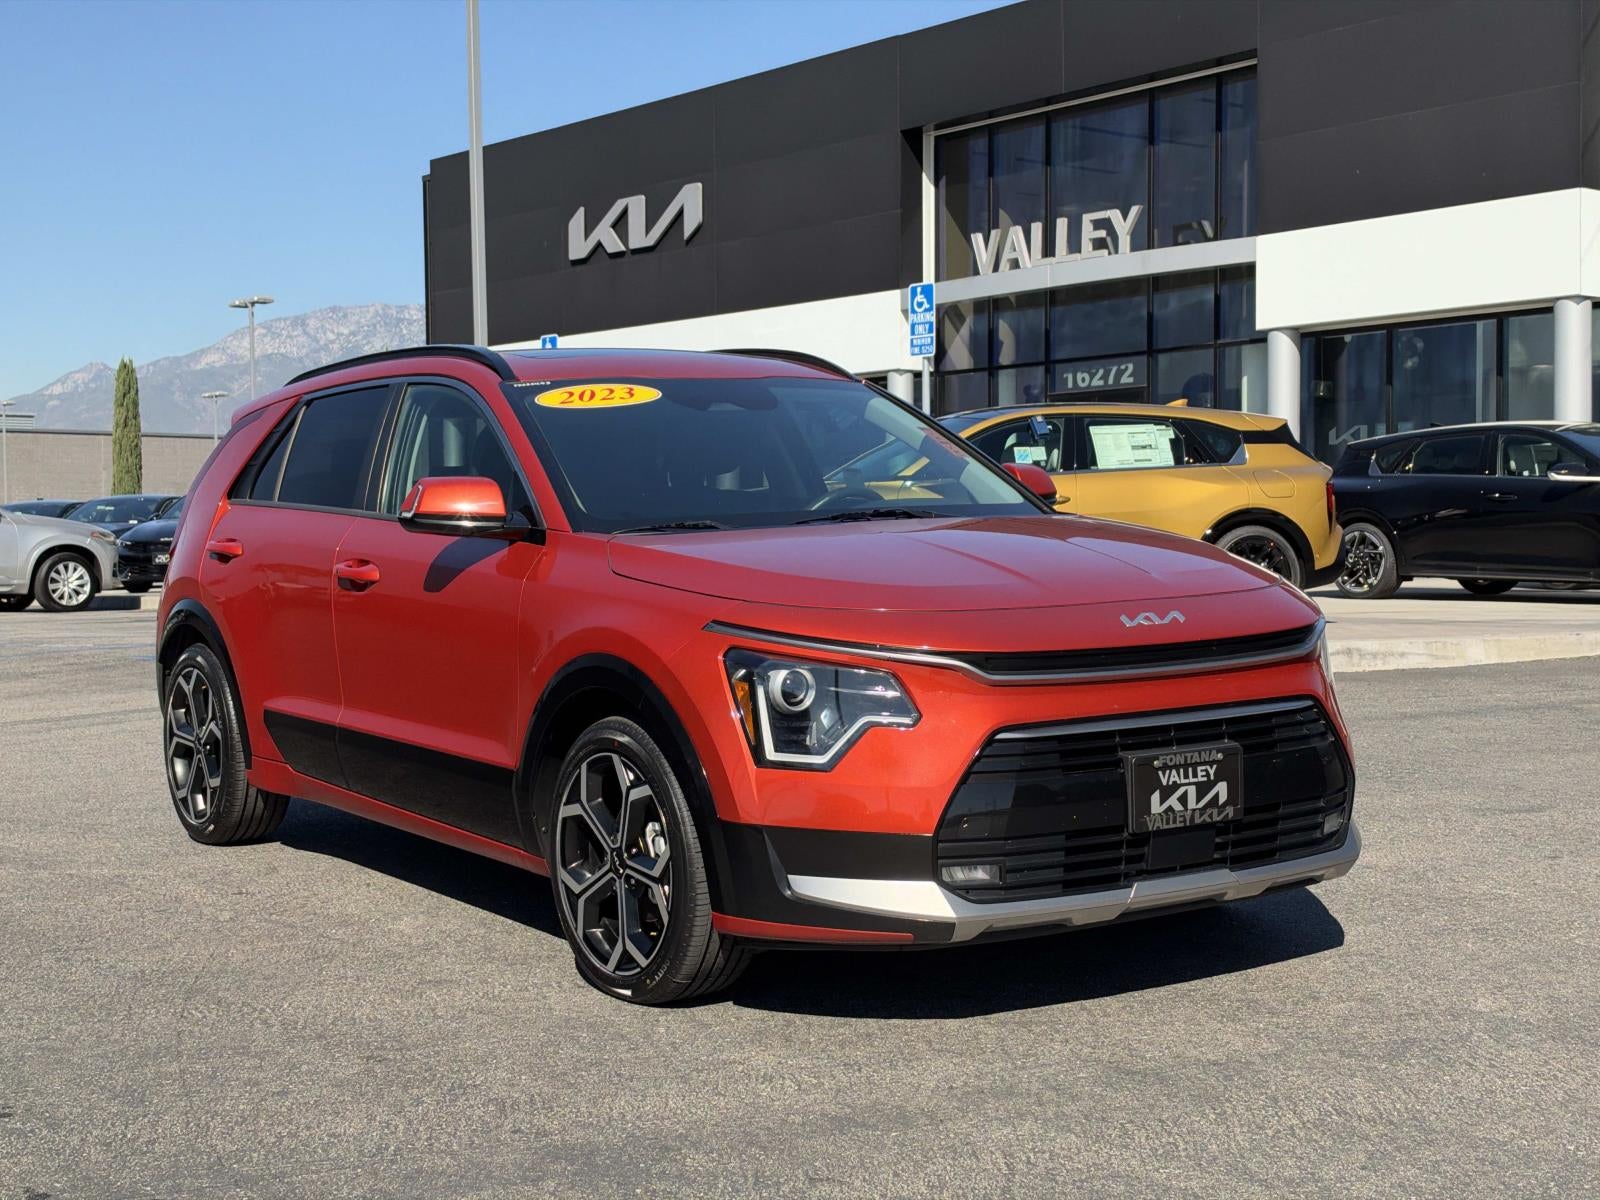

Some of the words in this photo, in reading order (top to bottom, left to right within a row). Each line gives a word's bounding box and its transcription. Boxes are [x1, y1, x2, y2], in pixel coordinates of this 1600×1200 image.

[568, 182, 703, 261] KIA
[971, 205, 1143, 276] VALLEY
[911, 311, 934, 323] PARKING
[914, 324, 929, 335] ONLY
[1063, 362, 1134, 389] 16272
[560, 387, 635, 405] 2023
[1119, 610, 1185, 628] KIA
[1158, 750, 1217, 766] FONTANA
[1158, 764, 1217, 786] VALLEY
[1150, 781, 1227, 814] KIA
[1145, 809, 1192, 831] VALLEY
[1195, 805, 1234, 824] KIA
